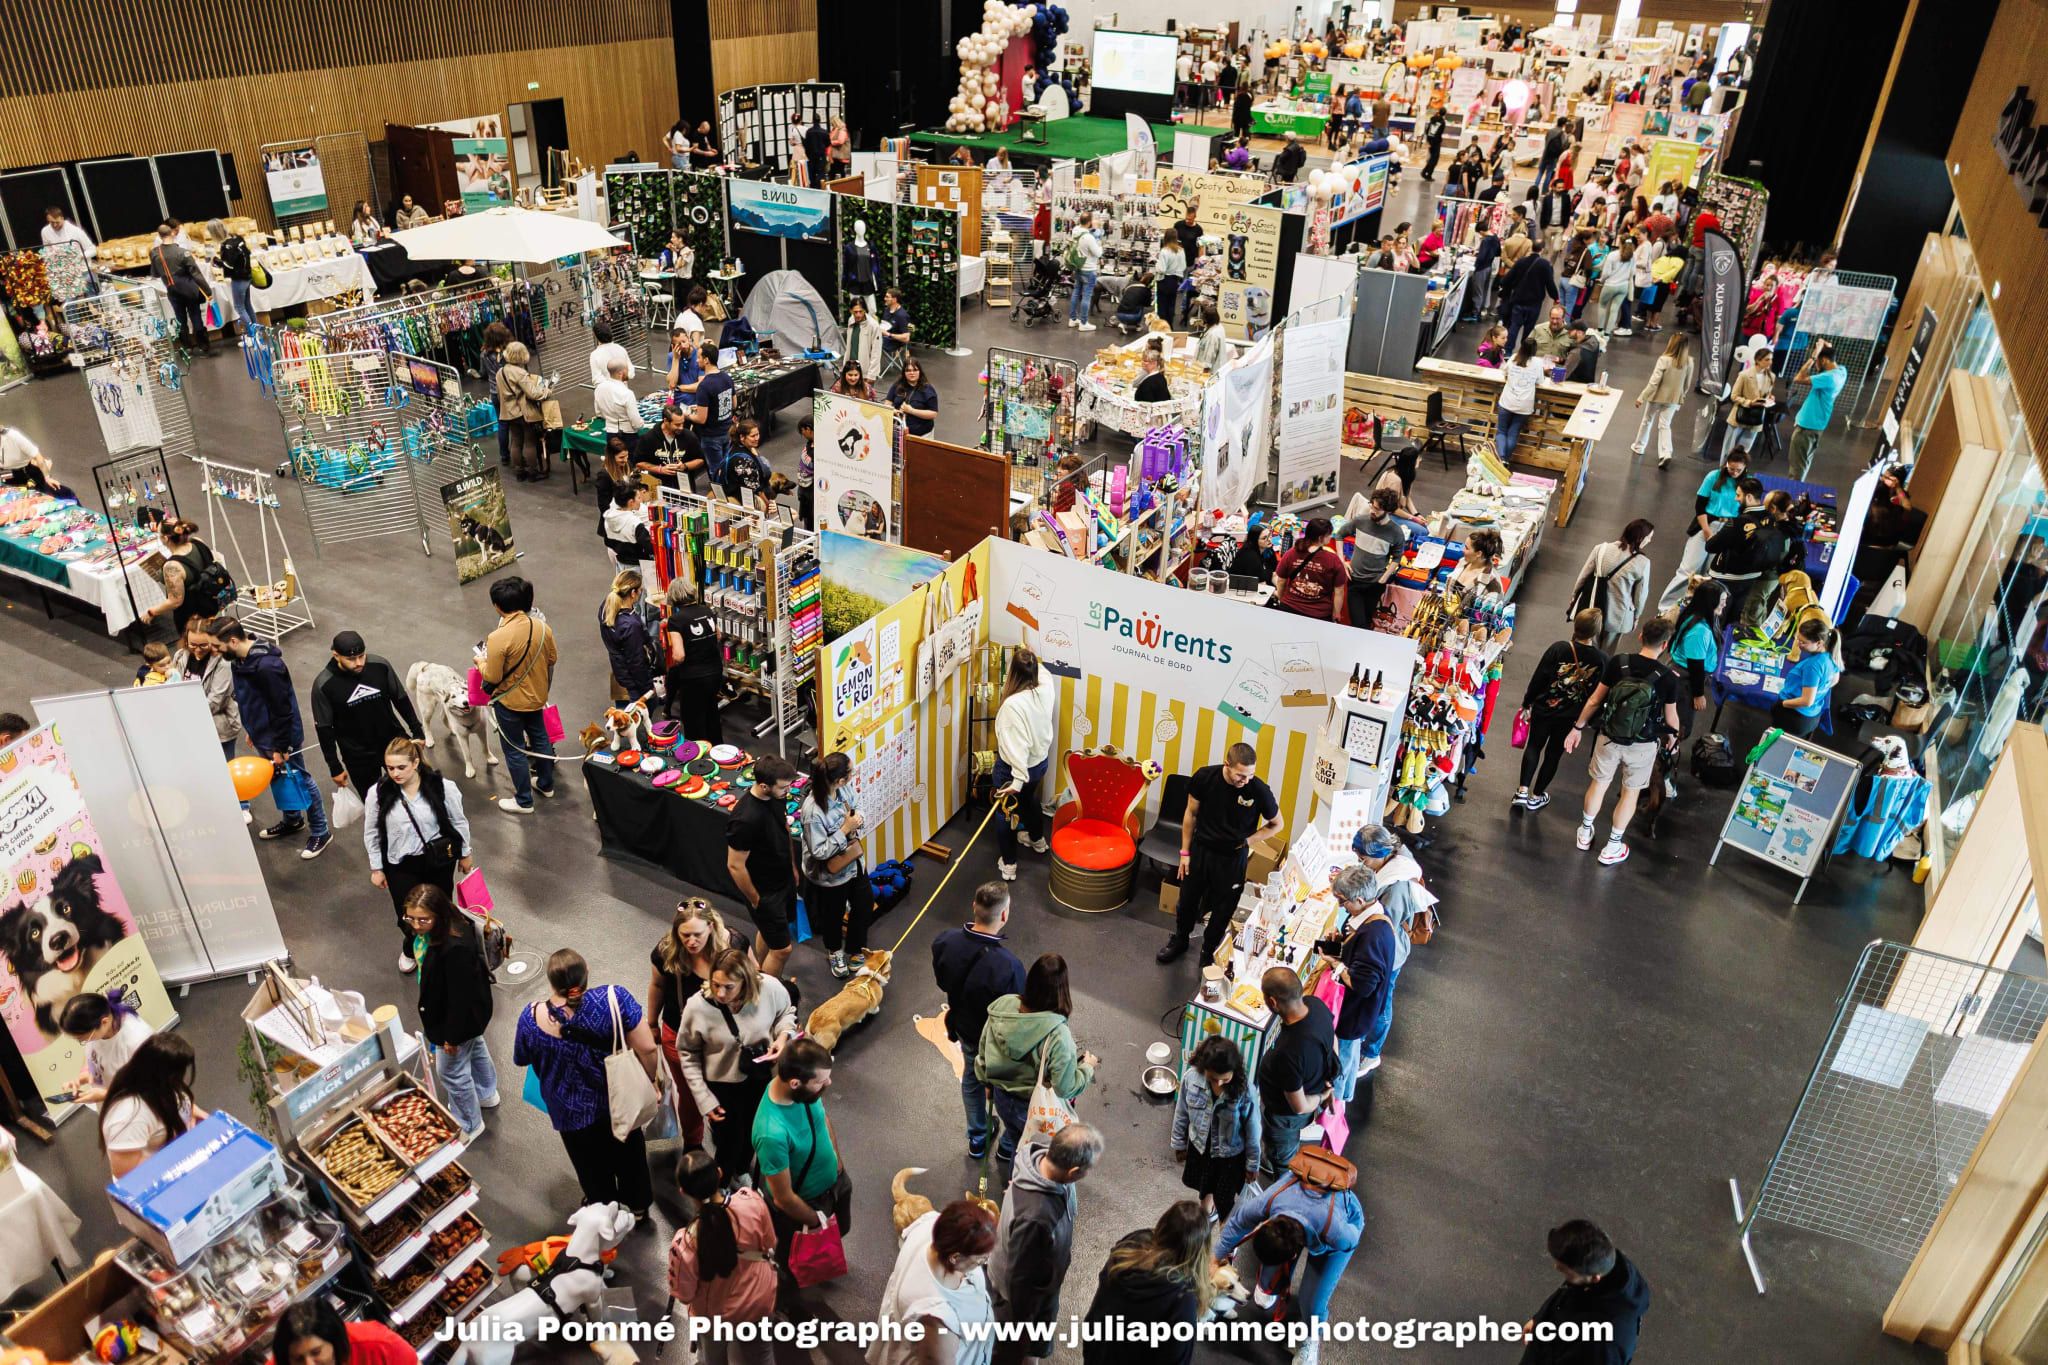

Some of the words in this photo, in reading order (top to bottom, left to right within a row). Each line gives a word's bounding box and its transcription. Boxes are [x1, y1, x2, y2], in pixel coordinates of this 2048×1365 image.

[1278, 114, 1296, 125] AVF
[761, 189, 798, 205] B.WILD
[456, 476, 483, 494] B.WILD
[1084, 601, 1102, 629] Les
[1111, 643, 1151, 662] JOURNAL
[1153, 655, 1165, 665] DE
[1168, 660, 1193, 672] BORD
[836, 664, 873, 700] LEMON
[1315, 771, 1332, 786] CLUB
[0, 785, 48, 839] OOKA
[34, 805, 55, 824] CHATS
[8, 846, 17, 857] ET
[16, 834, 35, 849] VOUS
[298, 1079, 343, 1113] SNACK
[344, 1056, 371, 1080] BAR
